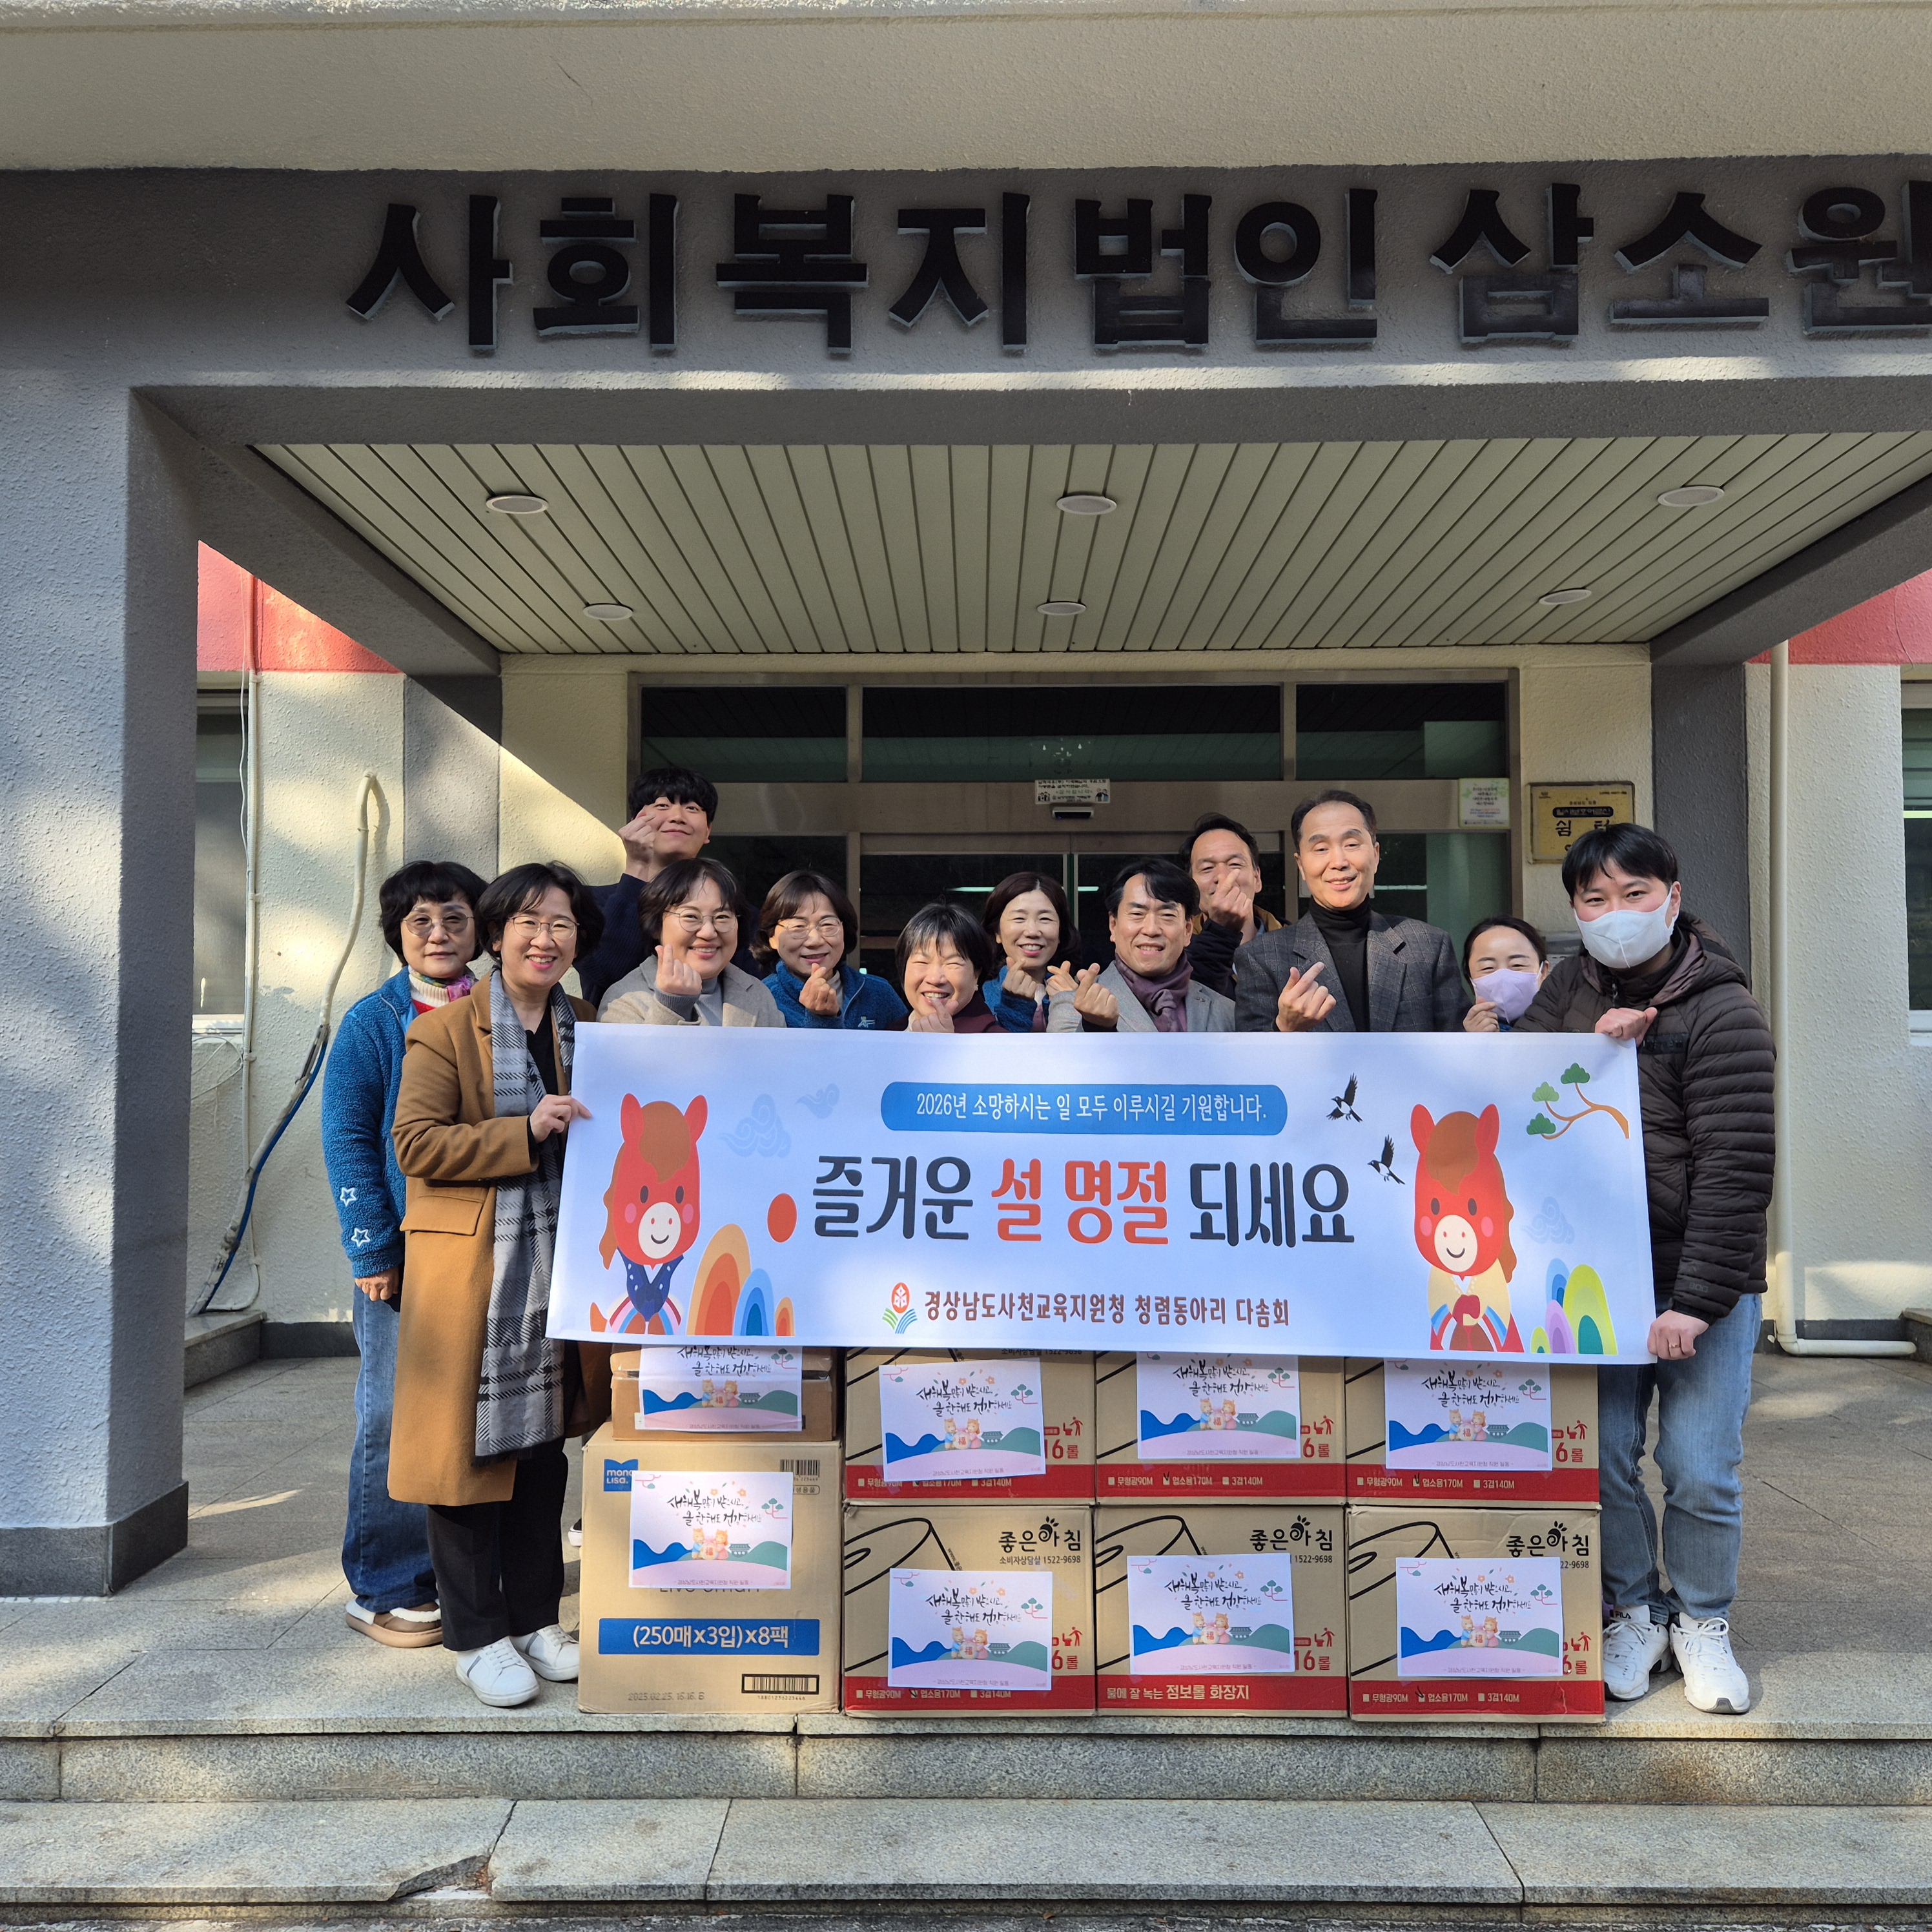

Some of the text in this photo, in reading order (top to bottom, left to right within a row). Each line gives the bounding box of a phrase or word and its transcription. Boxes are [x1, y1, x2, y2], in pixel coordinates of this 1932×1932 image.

[345, 180, 1932, 355] 사회복지법인 삼소원
[916, 1092, 1267, 1124] 2026년 소망하시는 일 모두 이루시길 기원합니다.
[813, 1155, 1355, 1247] 즐거운 설 명절 되세요
[924, 1290, 1289, 1328] 경상남도사천교육지원청 청렴동아리 다솜회
[1303, 1437, 1330, 1457] 6롤
[1556, 1442, 1583, 1462] 6롤
[998, 1521, 1081, 1553] 좋은아침
[1249, 1520, 1332, 1551] 좋은아침
[1506, 1527, 1589, 1557] 좋은아침
[999, 1556, 1081, 1565] 소비자상담실 1522-9698
[1295, 1555, 1333, 1563] 1522-9698
[1615, 1610, 1631, 1619] FILA
[1051, 1650, 1078, 1670] 6롤
[1563, 1654, 1587, 1674] 6롤
[1129, 1687, 1141, 1700] 잘
[1143, 1687, 1164, 1700] 녹는
[1166, 1685, 1206, 1700] 점보롤
[1209, 1685, 1249, 1700] 화장지
